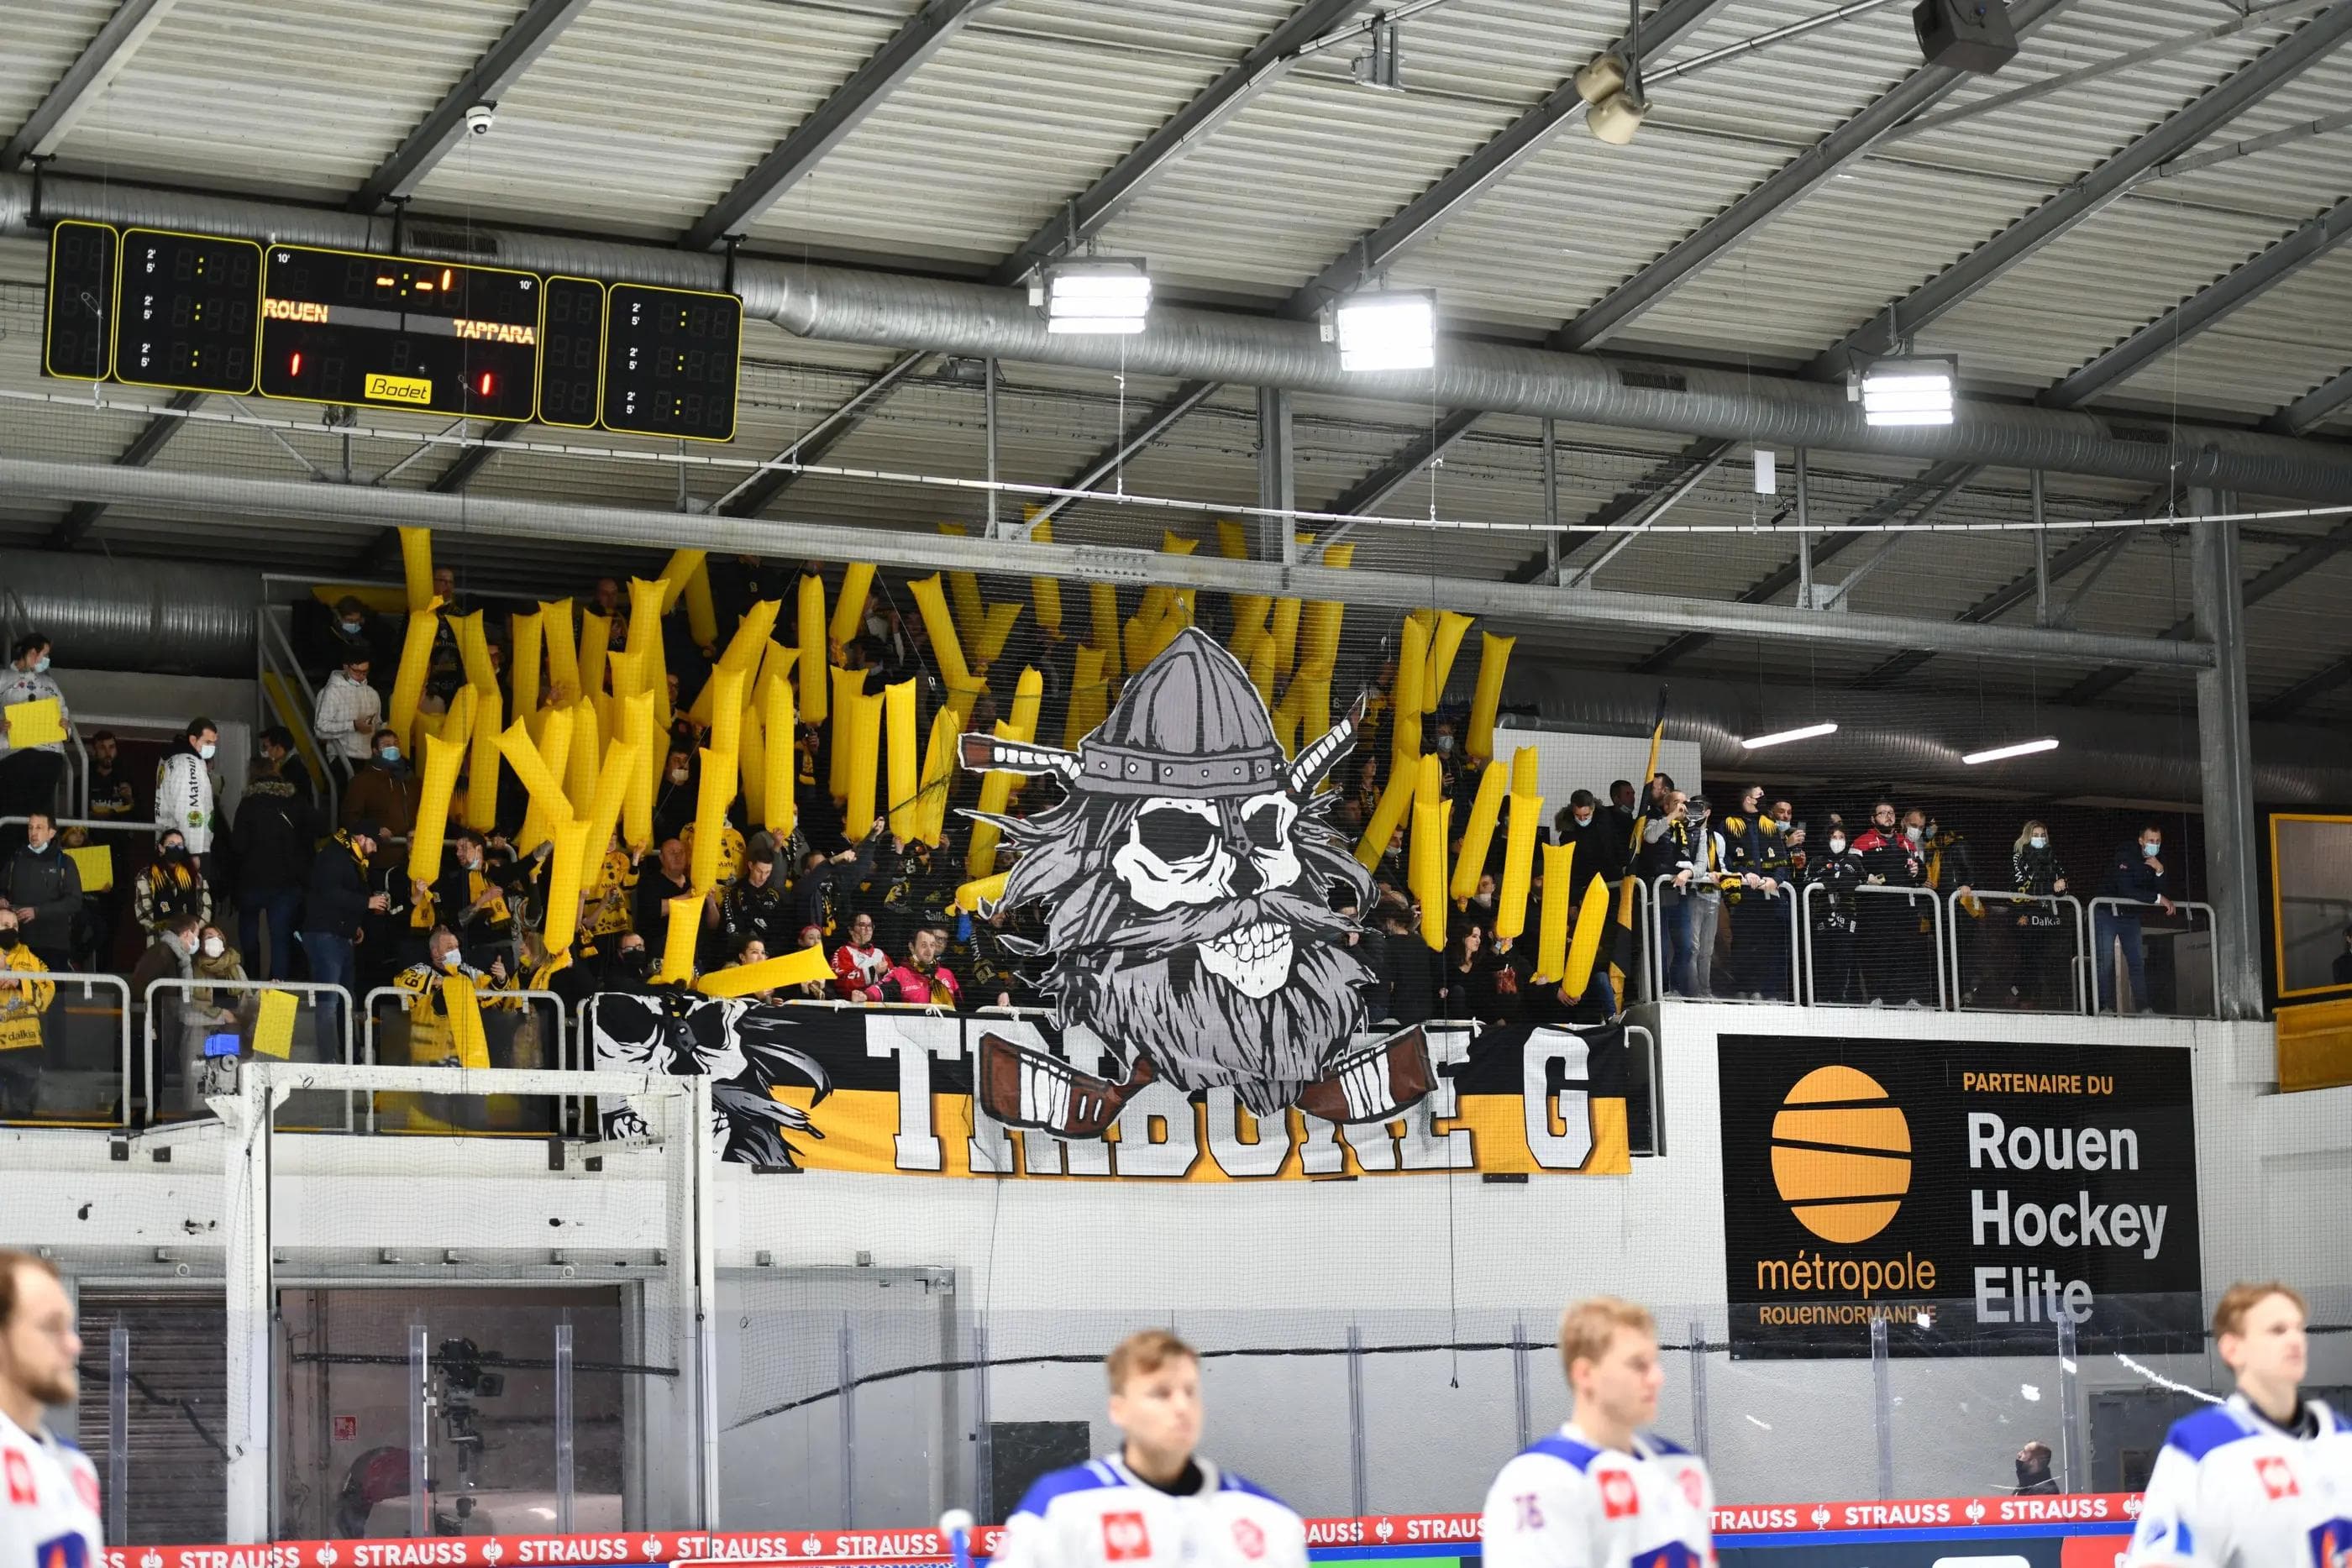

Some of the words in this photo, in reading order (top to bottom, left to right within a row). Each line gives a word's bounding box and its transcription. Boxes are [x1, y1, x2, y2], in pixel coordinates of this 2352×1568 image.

[264, 298, 328, 323] ROUEN
[454, 318, 536, 345] TAPPARA
[370, 378, 428, 400] Bodet
[1964, 1072, 2082, 1094] PARTENAIRE
[2087, 1076, 2113, 1094] DU
[1523, 1026, 1593, 1170] G
[1968, 1112, 2139, 1171] Rouen
[1971, 1190, 2168, 1260] Hockey
[1757, 1250, 1936, 1299] métropole
[1974, 1266, 2094, 1324] Elite
[1708, 1508, 1797, 1530] TRAUSS
[1845, 1502, 1950, 1525] STRAUSS
[2000, 1498, 2107, 1521] STRAUSS
[354, 1542, 467, 1567] STRAUSS
[518, 1539, 628, 1562] STRAUSS
[677, 1536, 787, 1559] STRAUSS
[836, 1533, 938, 1555] STRAUSS
[179, 1546, 301, 1568] STRAUSS
